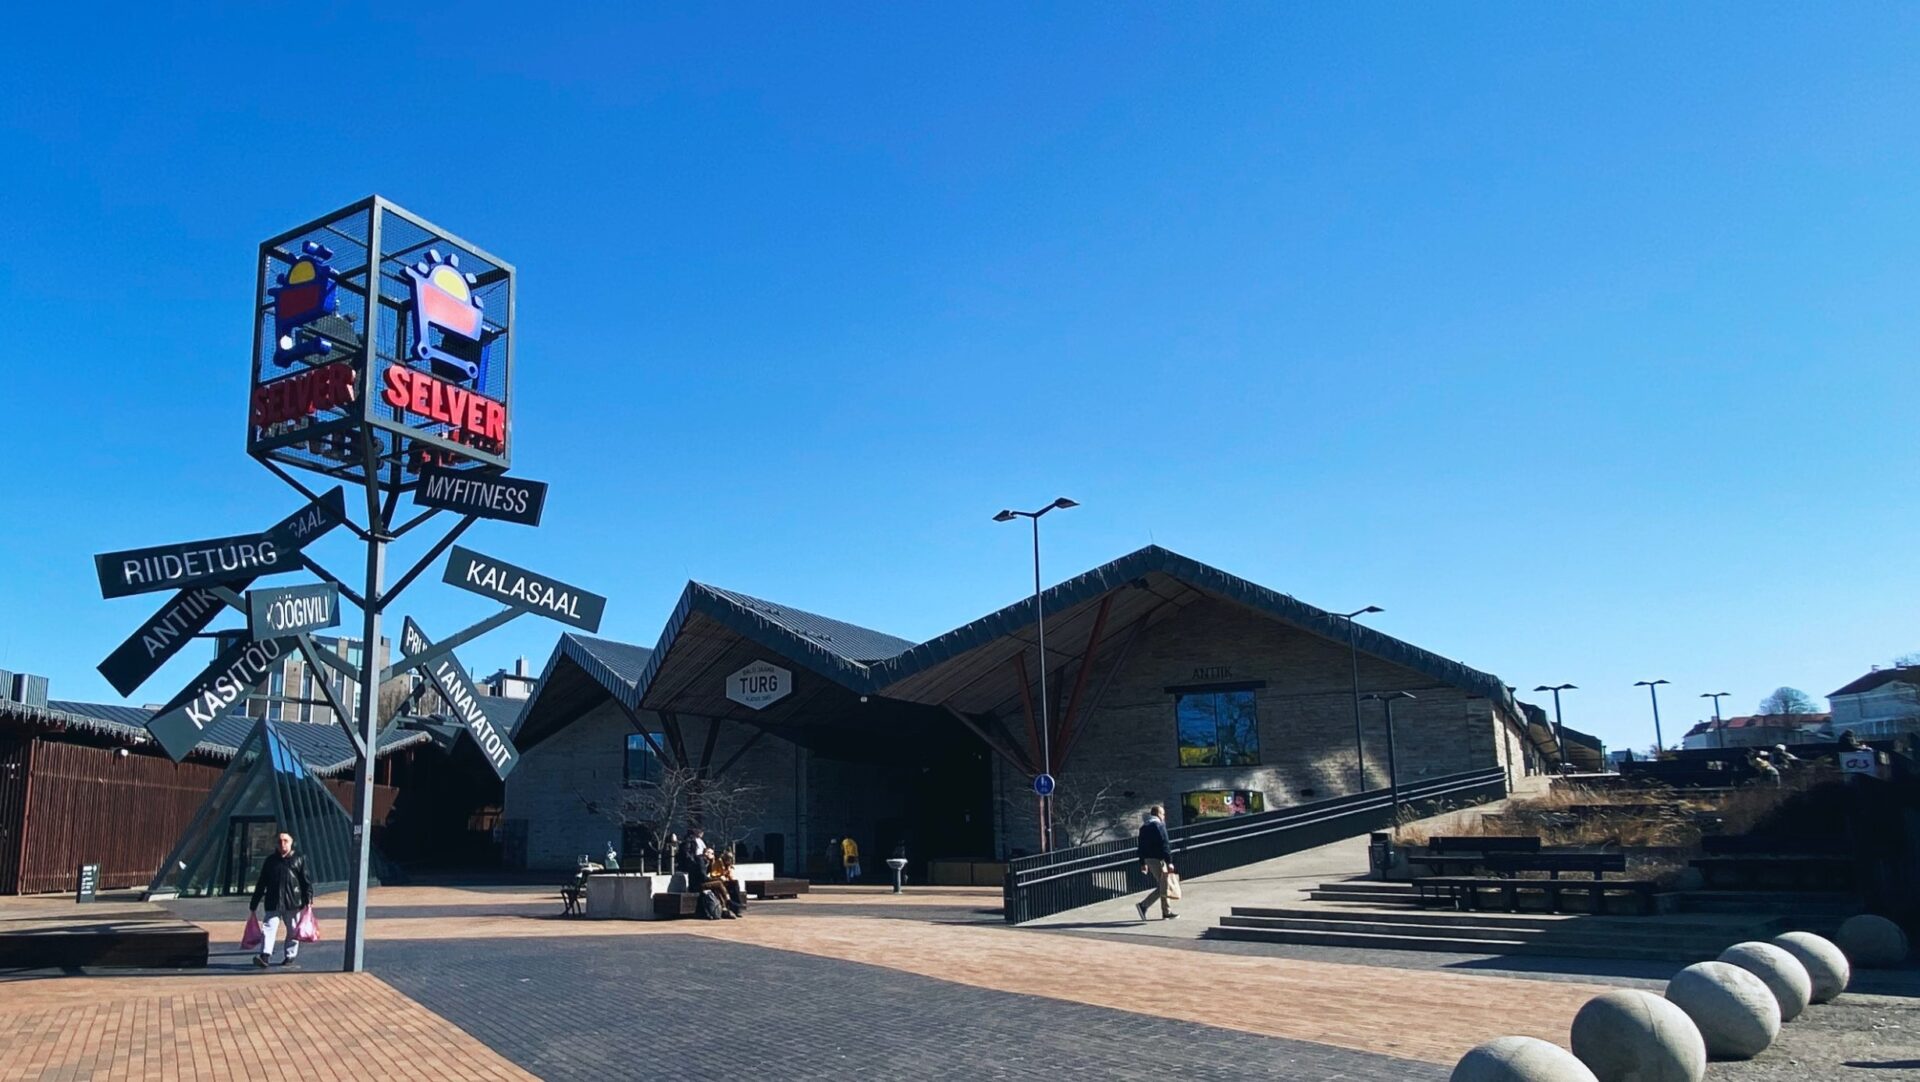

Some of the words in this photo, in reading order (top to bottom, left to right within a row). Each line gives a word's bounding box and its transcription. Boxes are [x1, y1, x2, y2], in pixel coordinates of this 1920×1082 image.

[382, 363, 506, 443] SELVER
[426, 475, 529, 514] MYFITNESS
[122, 541, 277, 585] RIIDETURG
[466, 559, 581, 619] KALASAAL
[141, 586, 218, 658] ANTIIK
[739, 675, 778, 694] TURG
